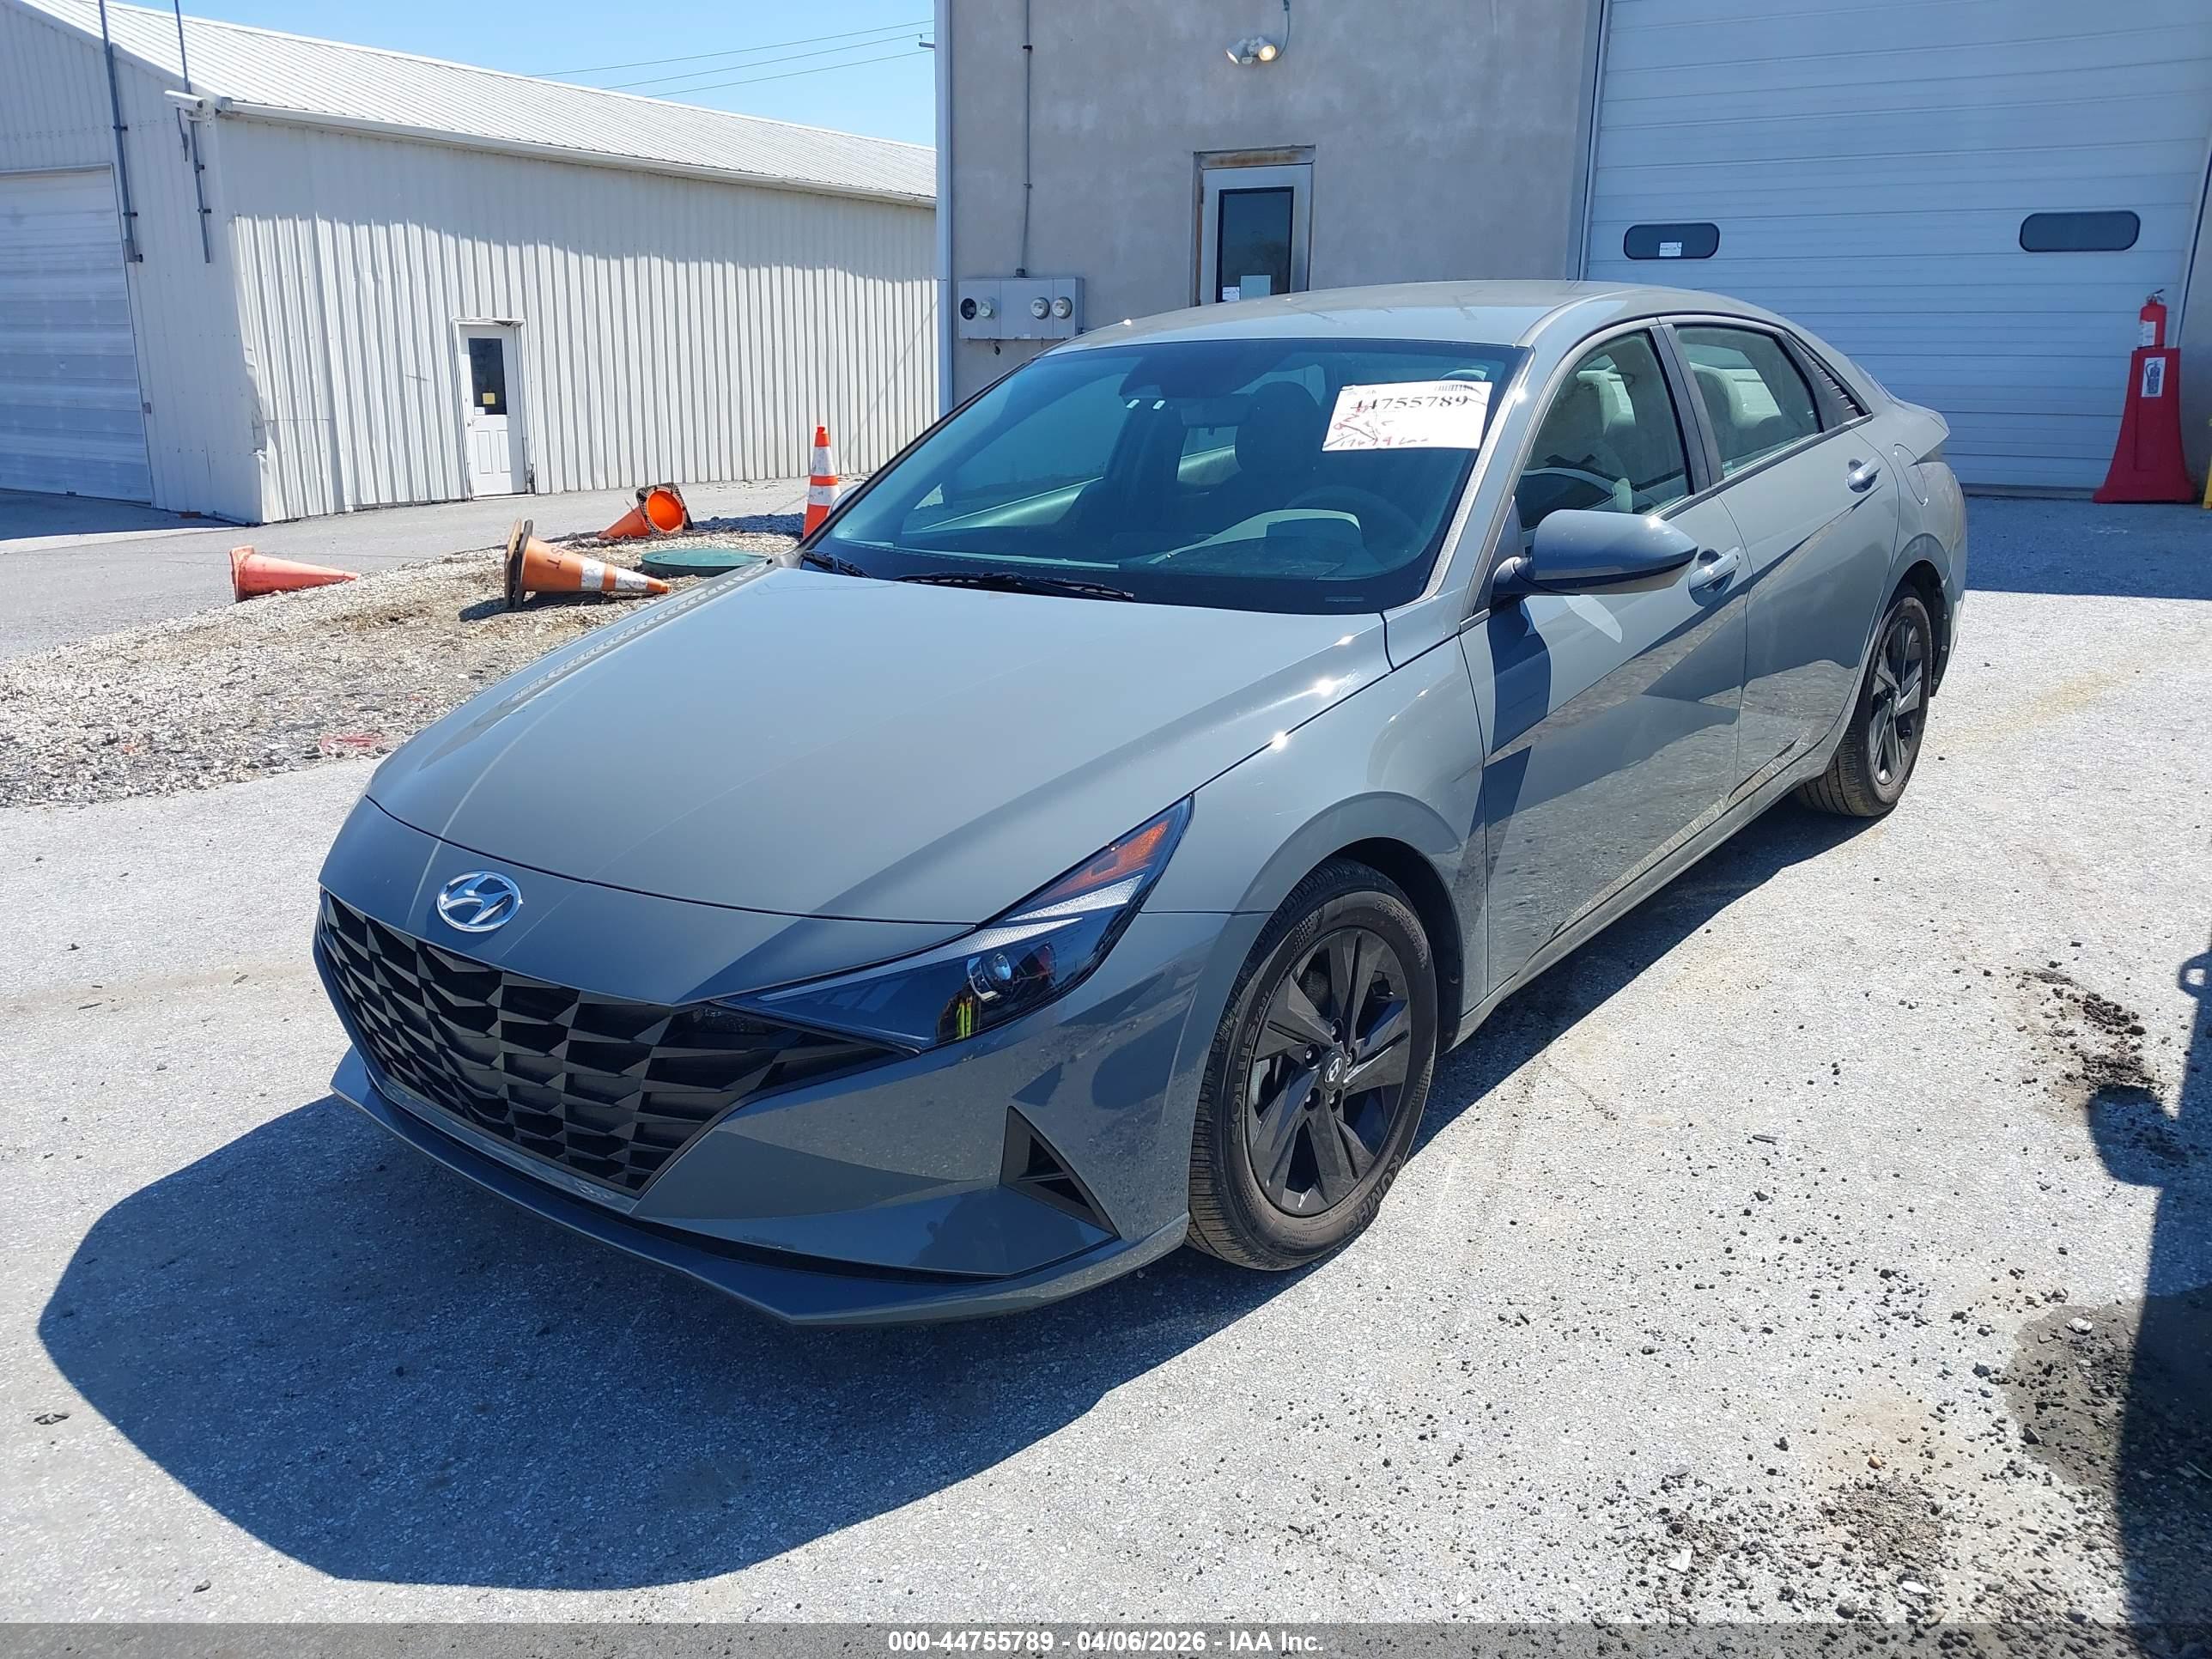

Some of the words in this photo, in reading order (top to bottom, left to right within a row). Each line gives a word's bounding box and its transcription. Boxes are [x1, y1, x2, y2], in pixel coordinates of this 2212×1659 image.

[1350, 395, 1468, 410] 44755789
[1231, 1023, 1256, 1144] SOLUS
[1344, 1153, 1402, 1237] KUMHO
